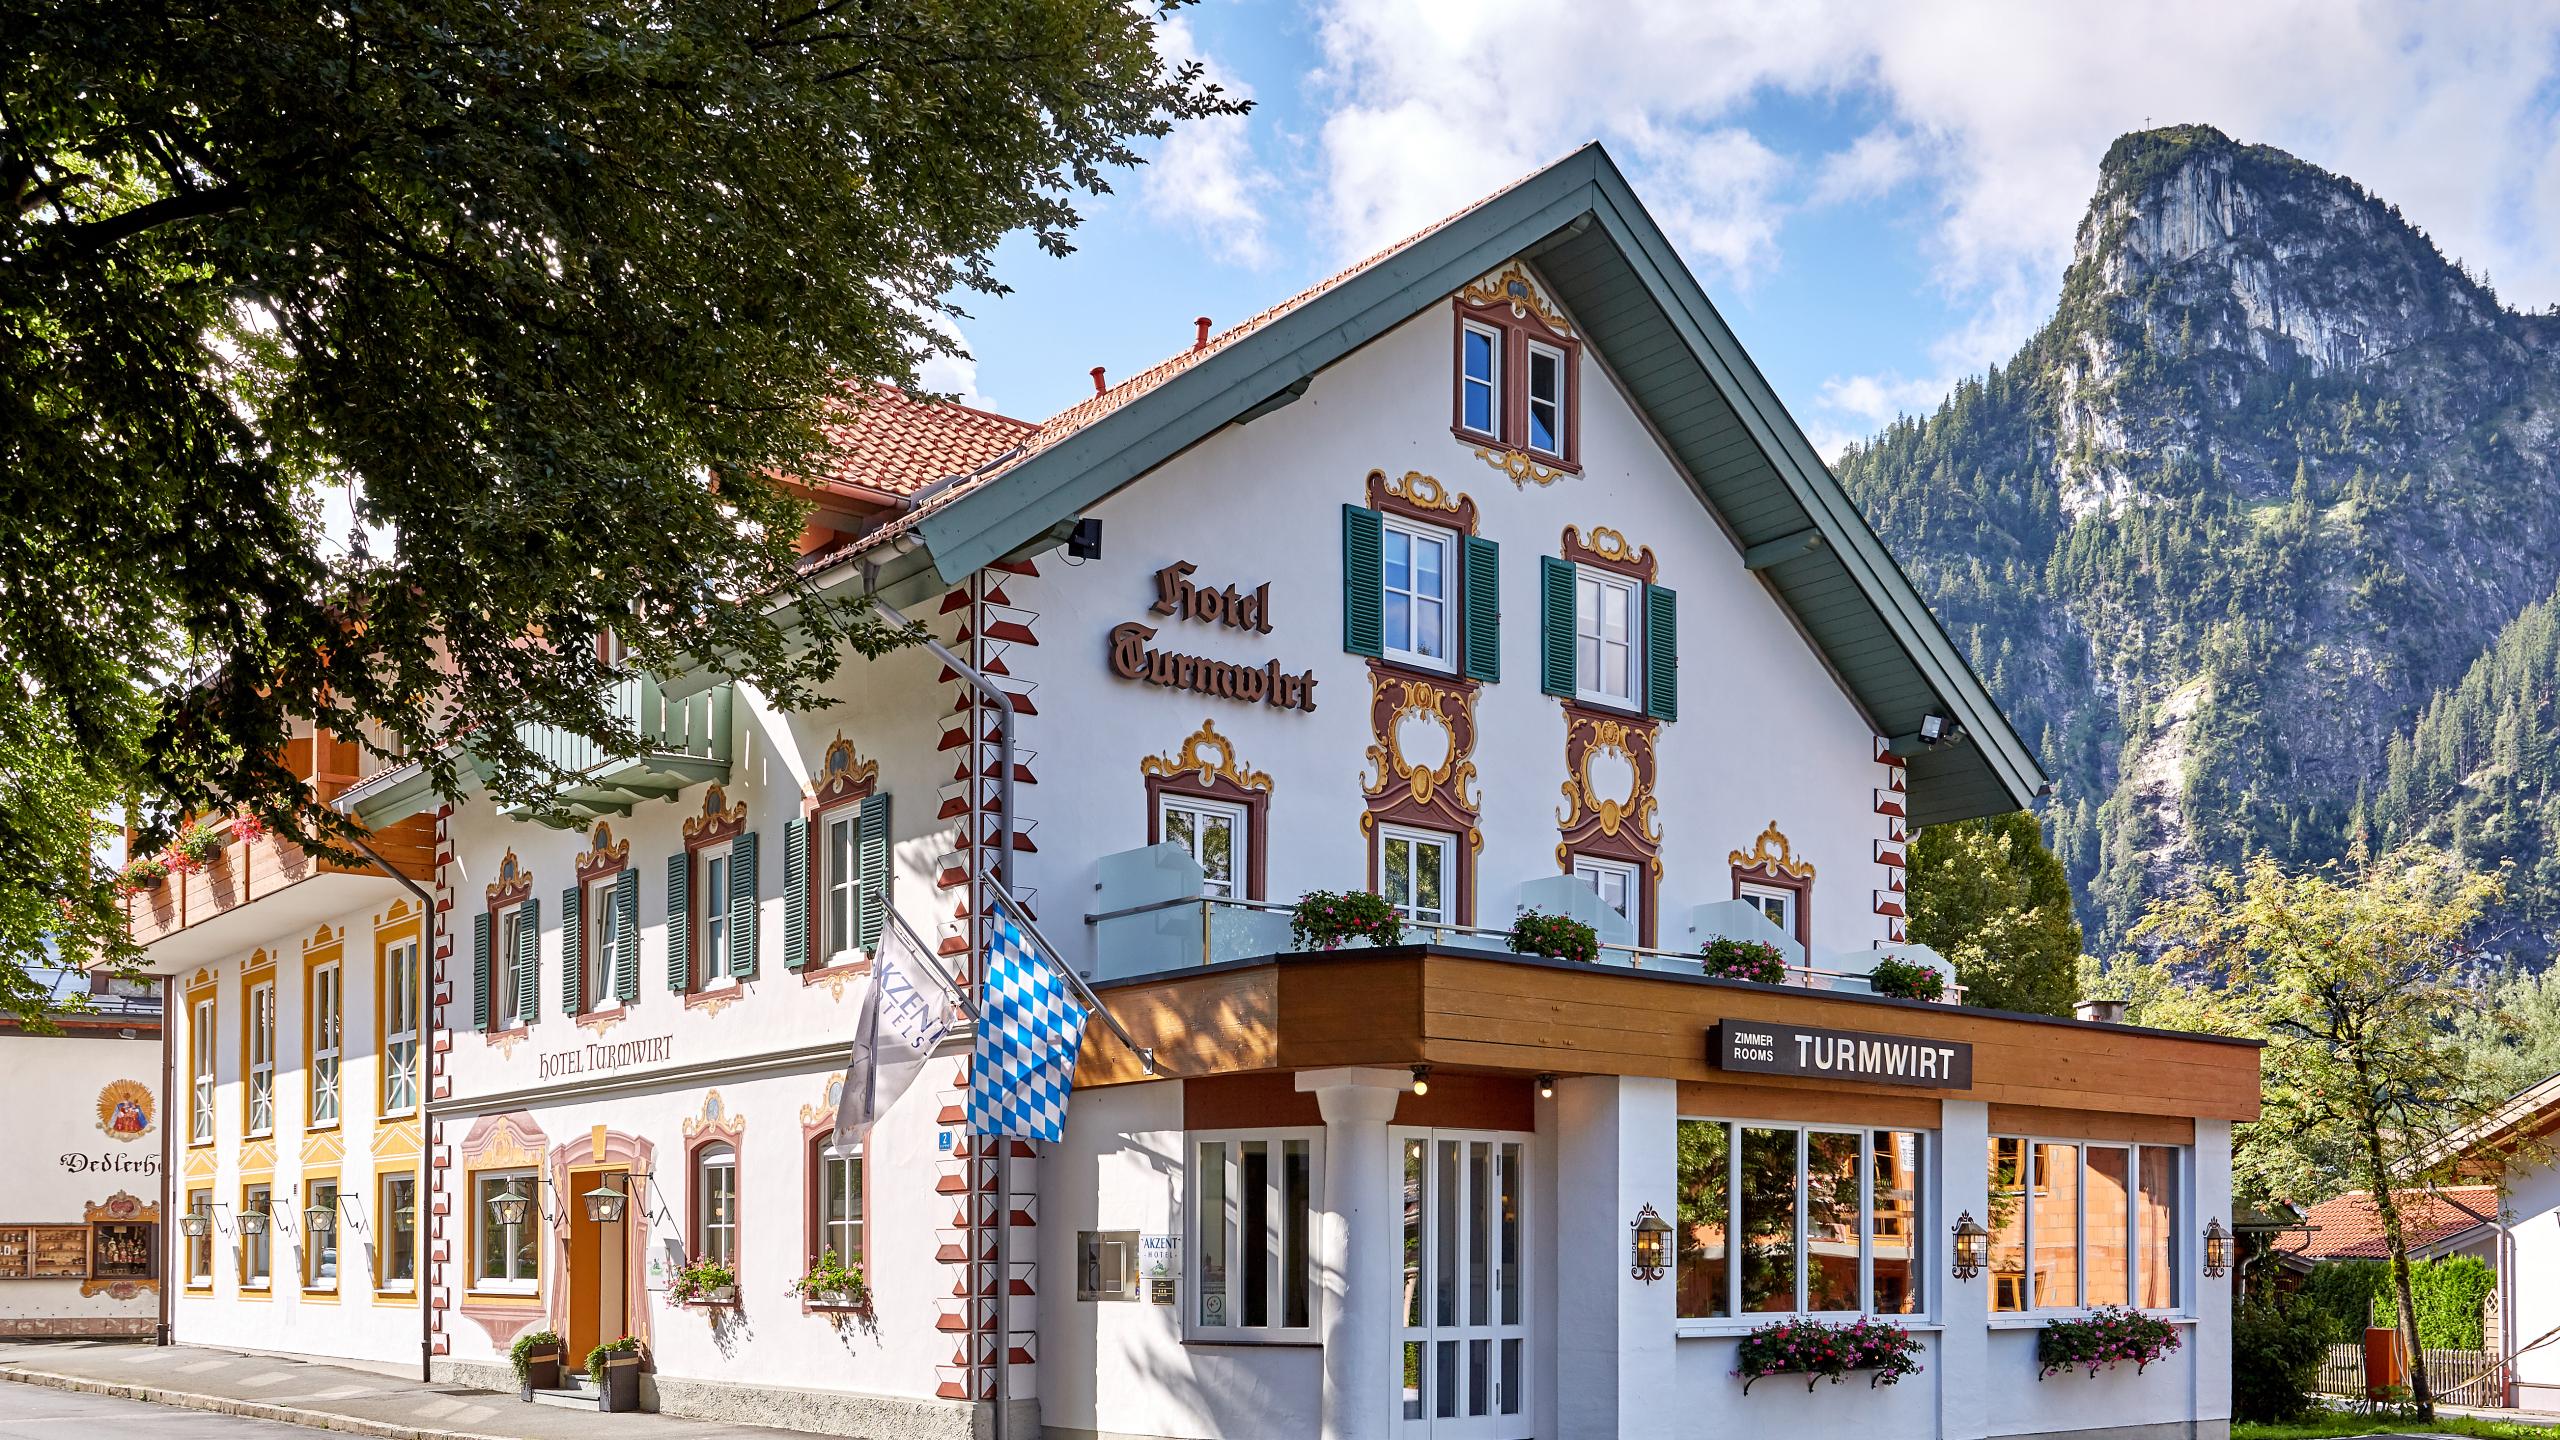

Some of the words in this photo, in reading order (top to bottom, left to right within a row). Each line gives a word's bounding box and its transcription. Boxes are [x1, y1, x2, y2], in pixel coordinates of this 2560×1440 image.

[1149, 560, 1273, 634] Hotel
[1110, 622, 1318, 713] Turmwirt
[1734, 1032, 1773, 1047] ZIMMER
[1734, 1047, 1774, 1062] ROOMS
[1794, 1034, 1955, 1080] TURMWIRT
[59, 1152, 161, 1176] Dedlerh
[1143, 1237, 1177, 1249] AKZENT
[1147, 1251, 1173, 1259] HOTEL
